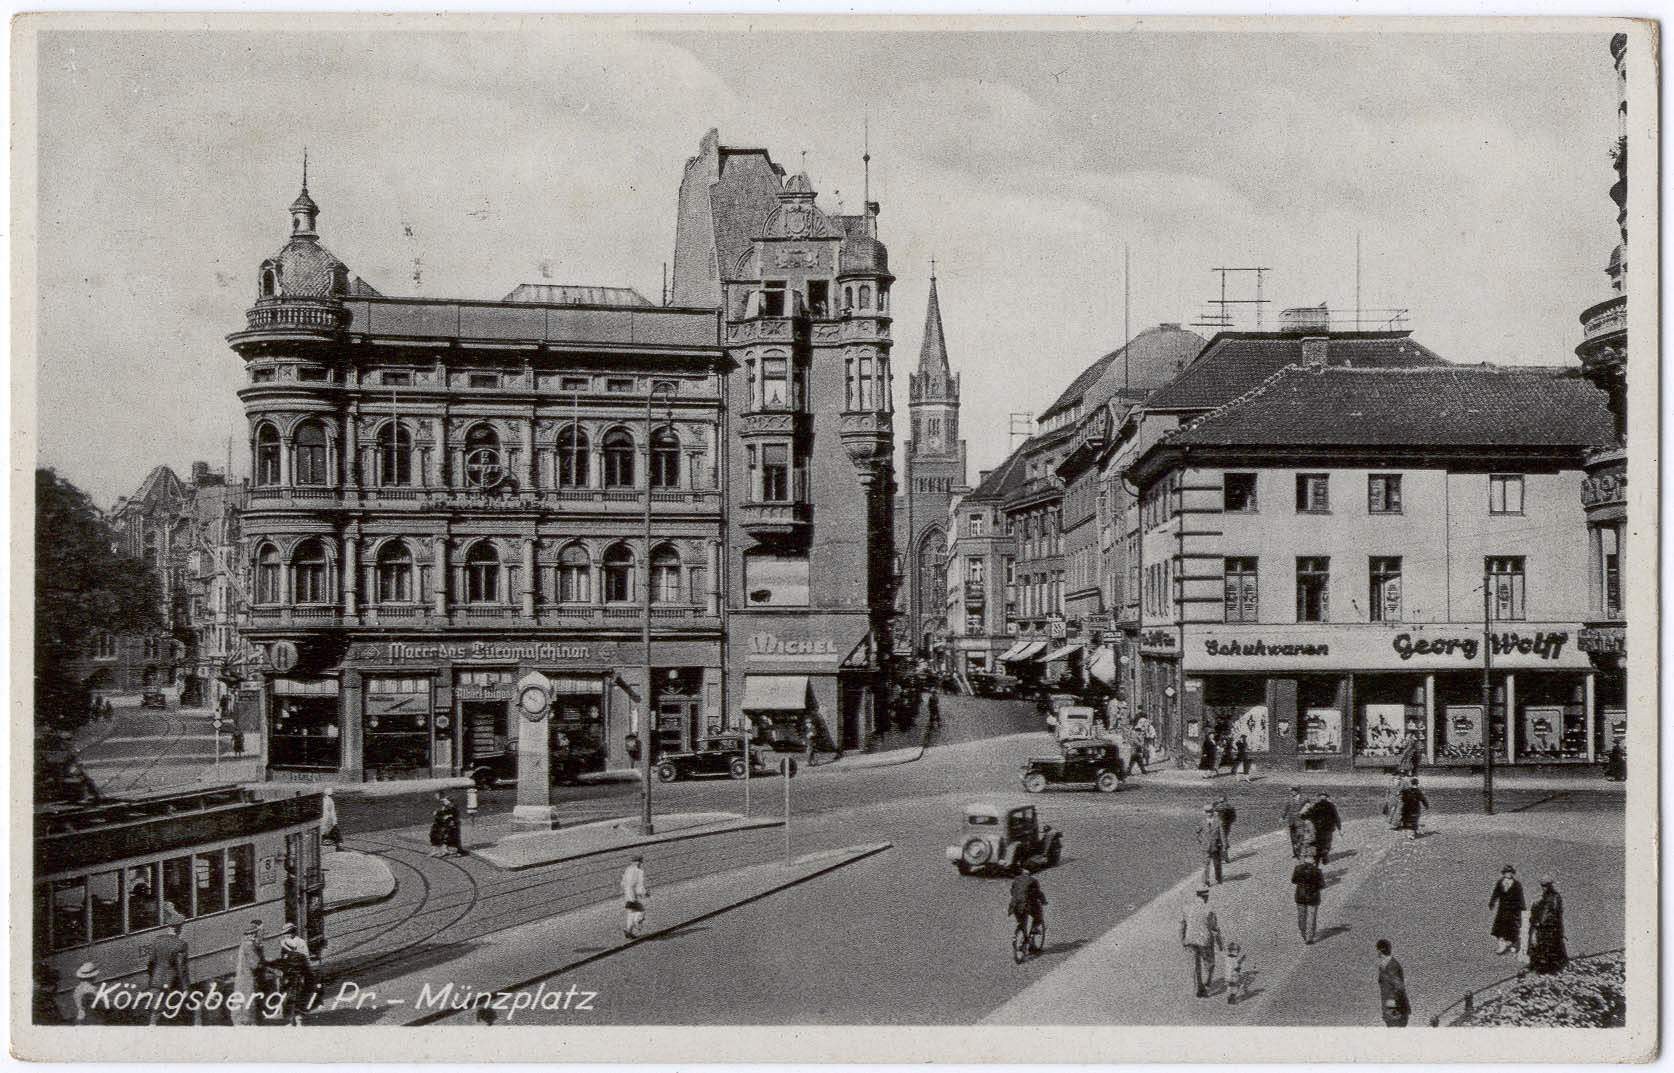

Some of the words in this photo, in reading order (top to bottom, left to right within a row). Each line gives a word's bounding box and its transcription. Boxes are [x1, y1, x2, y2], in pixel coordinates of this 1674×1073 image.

[747, 631, 838, 653] MICHEL
[1205, 639, 1329, 656] Schuhwaren
[1393, 633, 1478, 660] Georg
[1489, 632, 1569, 660] Wolff
